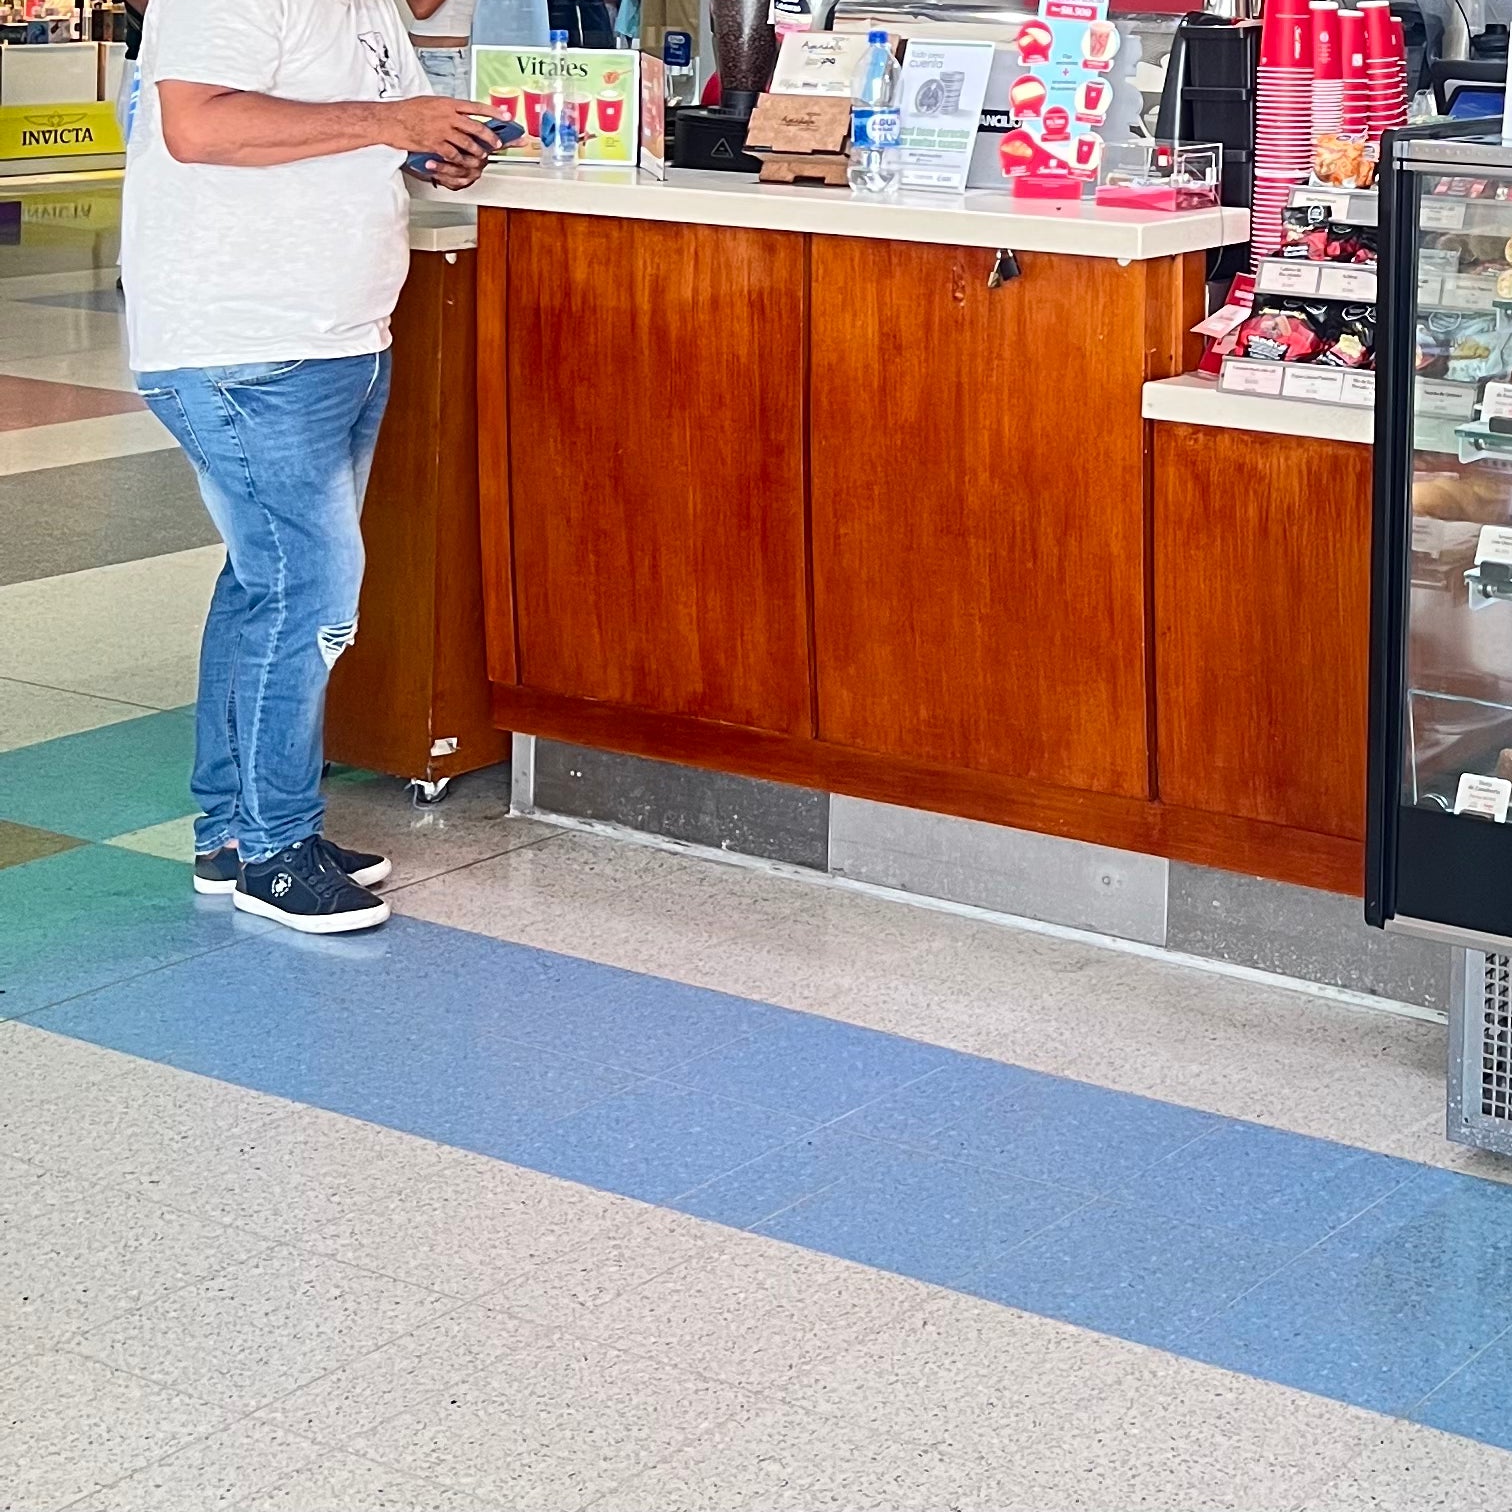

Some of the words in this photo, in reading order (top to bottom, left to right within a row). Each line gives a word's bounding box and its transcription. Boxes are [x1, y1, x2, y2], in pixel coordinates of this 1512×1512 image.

[909, 60, 943, 69] cuenta
[980, 114, 1022, 128] ANCILIO
[22, 128, 94, 146] INVICTA
